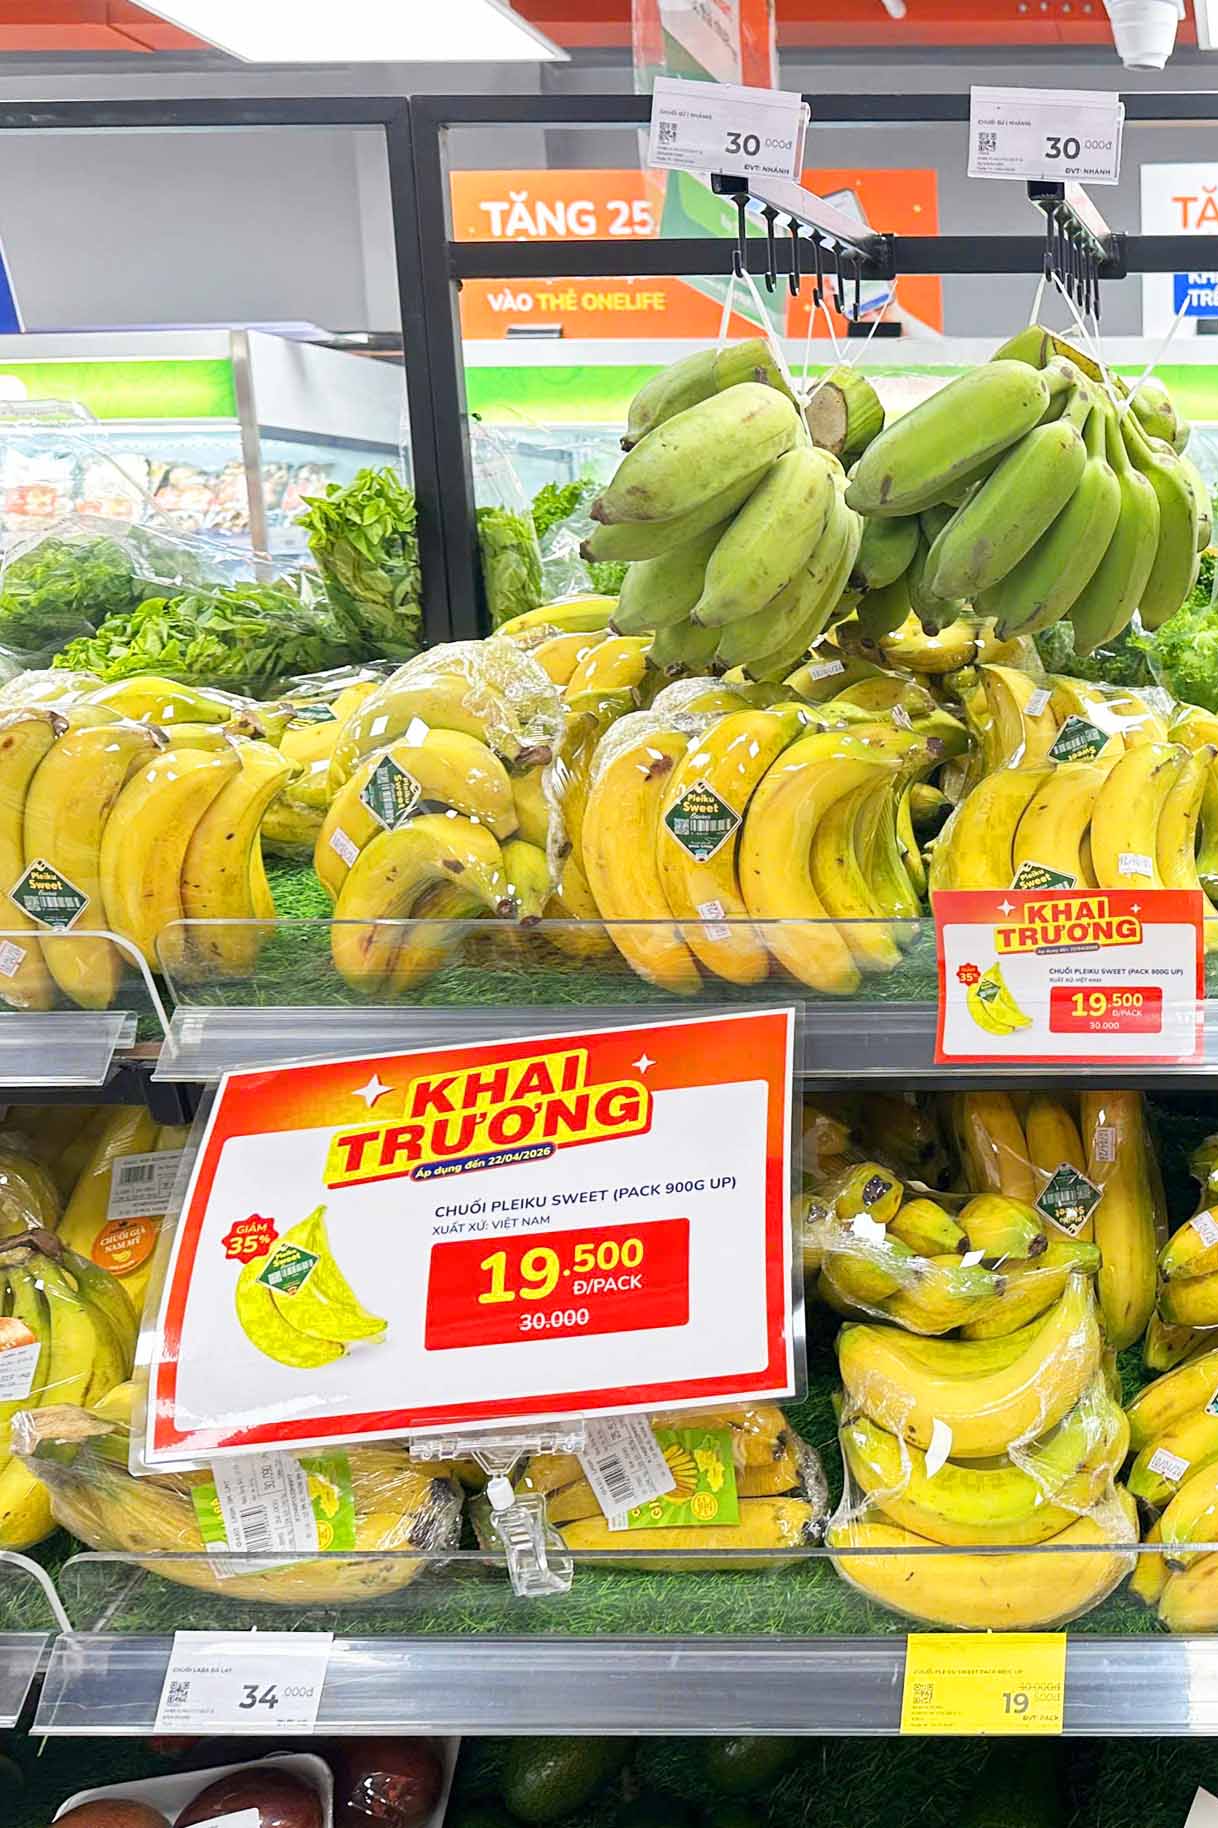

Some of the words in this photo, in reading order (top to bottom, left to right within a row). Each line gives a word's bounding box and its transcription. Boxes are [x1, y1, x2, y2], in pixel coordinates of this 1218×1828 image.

[725, 131, 761, 156] 30
[1045, 136, 1081, 160] 30
[487, 288, 534, 311] VÀO
[535, 288, 578, 311] THẺ
[581, 292, 665, 311] ONELIFE
[682, 802, 719, 813] Sweet
[688, 794, 715, 804] Pleiku
[28, 879, 64, 891] Sweet
[30, 871, 57, 881] Pleiku
[1019, 873, 1052, 890] Sweet
[1027, 899, 1106, 924] KHAI
[997, 919, 1137, 948] TRƯƠNG
[1049, 966, 1073, 975] CHUỐI
[1128, 968, 1149, 976] (PACK
[1171, 968, 1184, 976] UP)
[1089, 1021, 1120, 1030] 30.000
[411, 1055, 580, 1119] KHAI
[337, 1086, 641, 1173] TRƯƠNG
[415, 1167, 432, 1180] Áp
[434, 1163, 462, 1177] dụng
[464, 1157, 486, 1171] đến
[488, 1146, 552, 1167] 22/04/2026
[434, 1199, 486, 1219] CHUỐI
[491, 1196, 547, 1212] PLEIKU
[552, 1189, 609, 1207] SWEET
[613, 1184, 661, 1202] (PACK
[665, 1179, 706, 1195] 900G
[710, 1175, 737, 1191] UP)
[236, 1221, 268, 1234] GIẢM
[432, 1221, 465, 1236] XUẤT
[468, 1219, 489, 1233] XỨ:
[491, 1217, 520, 1231] VIỆT
[522, 1215, 551, 1226] NAM
[227, 1234, 271, 1256] 35%
[573, 1274, 643, 1296] Đ/PACK
[519, 1307, 590, 1332] 30.000
[238, 1684, 279, 1710] 34
[1002, 1692, 1030, 1714] 19
